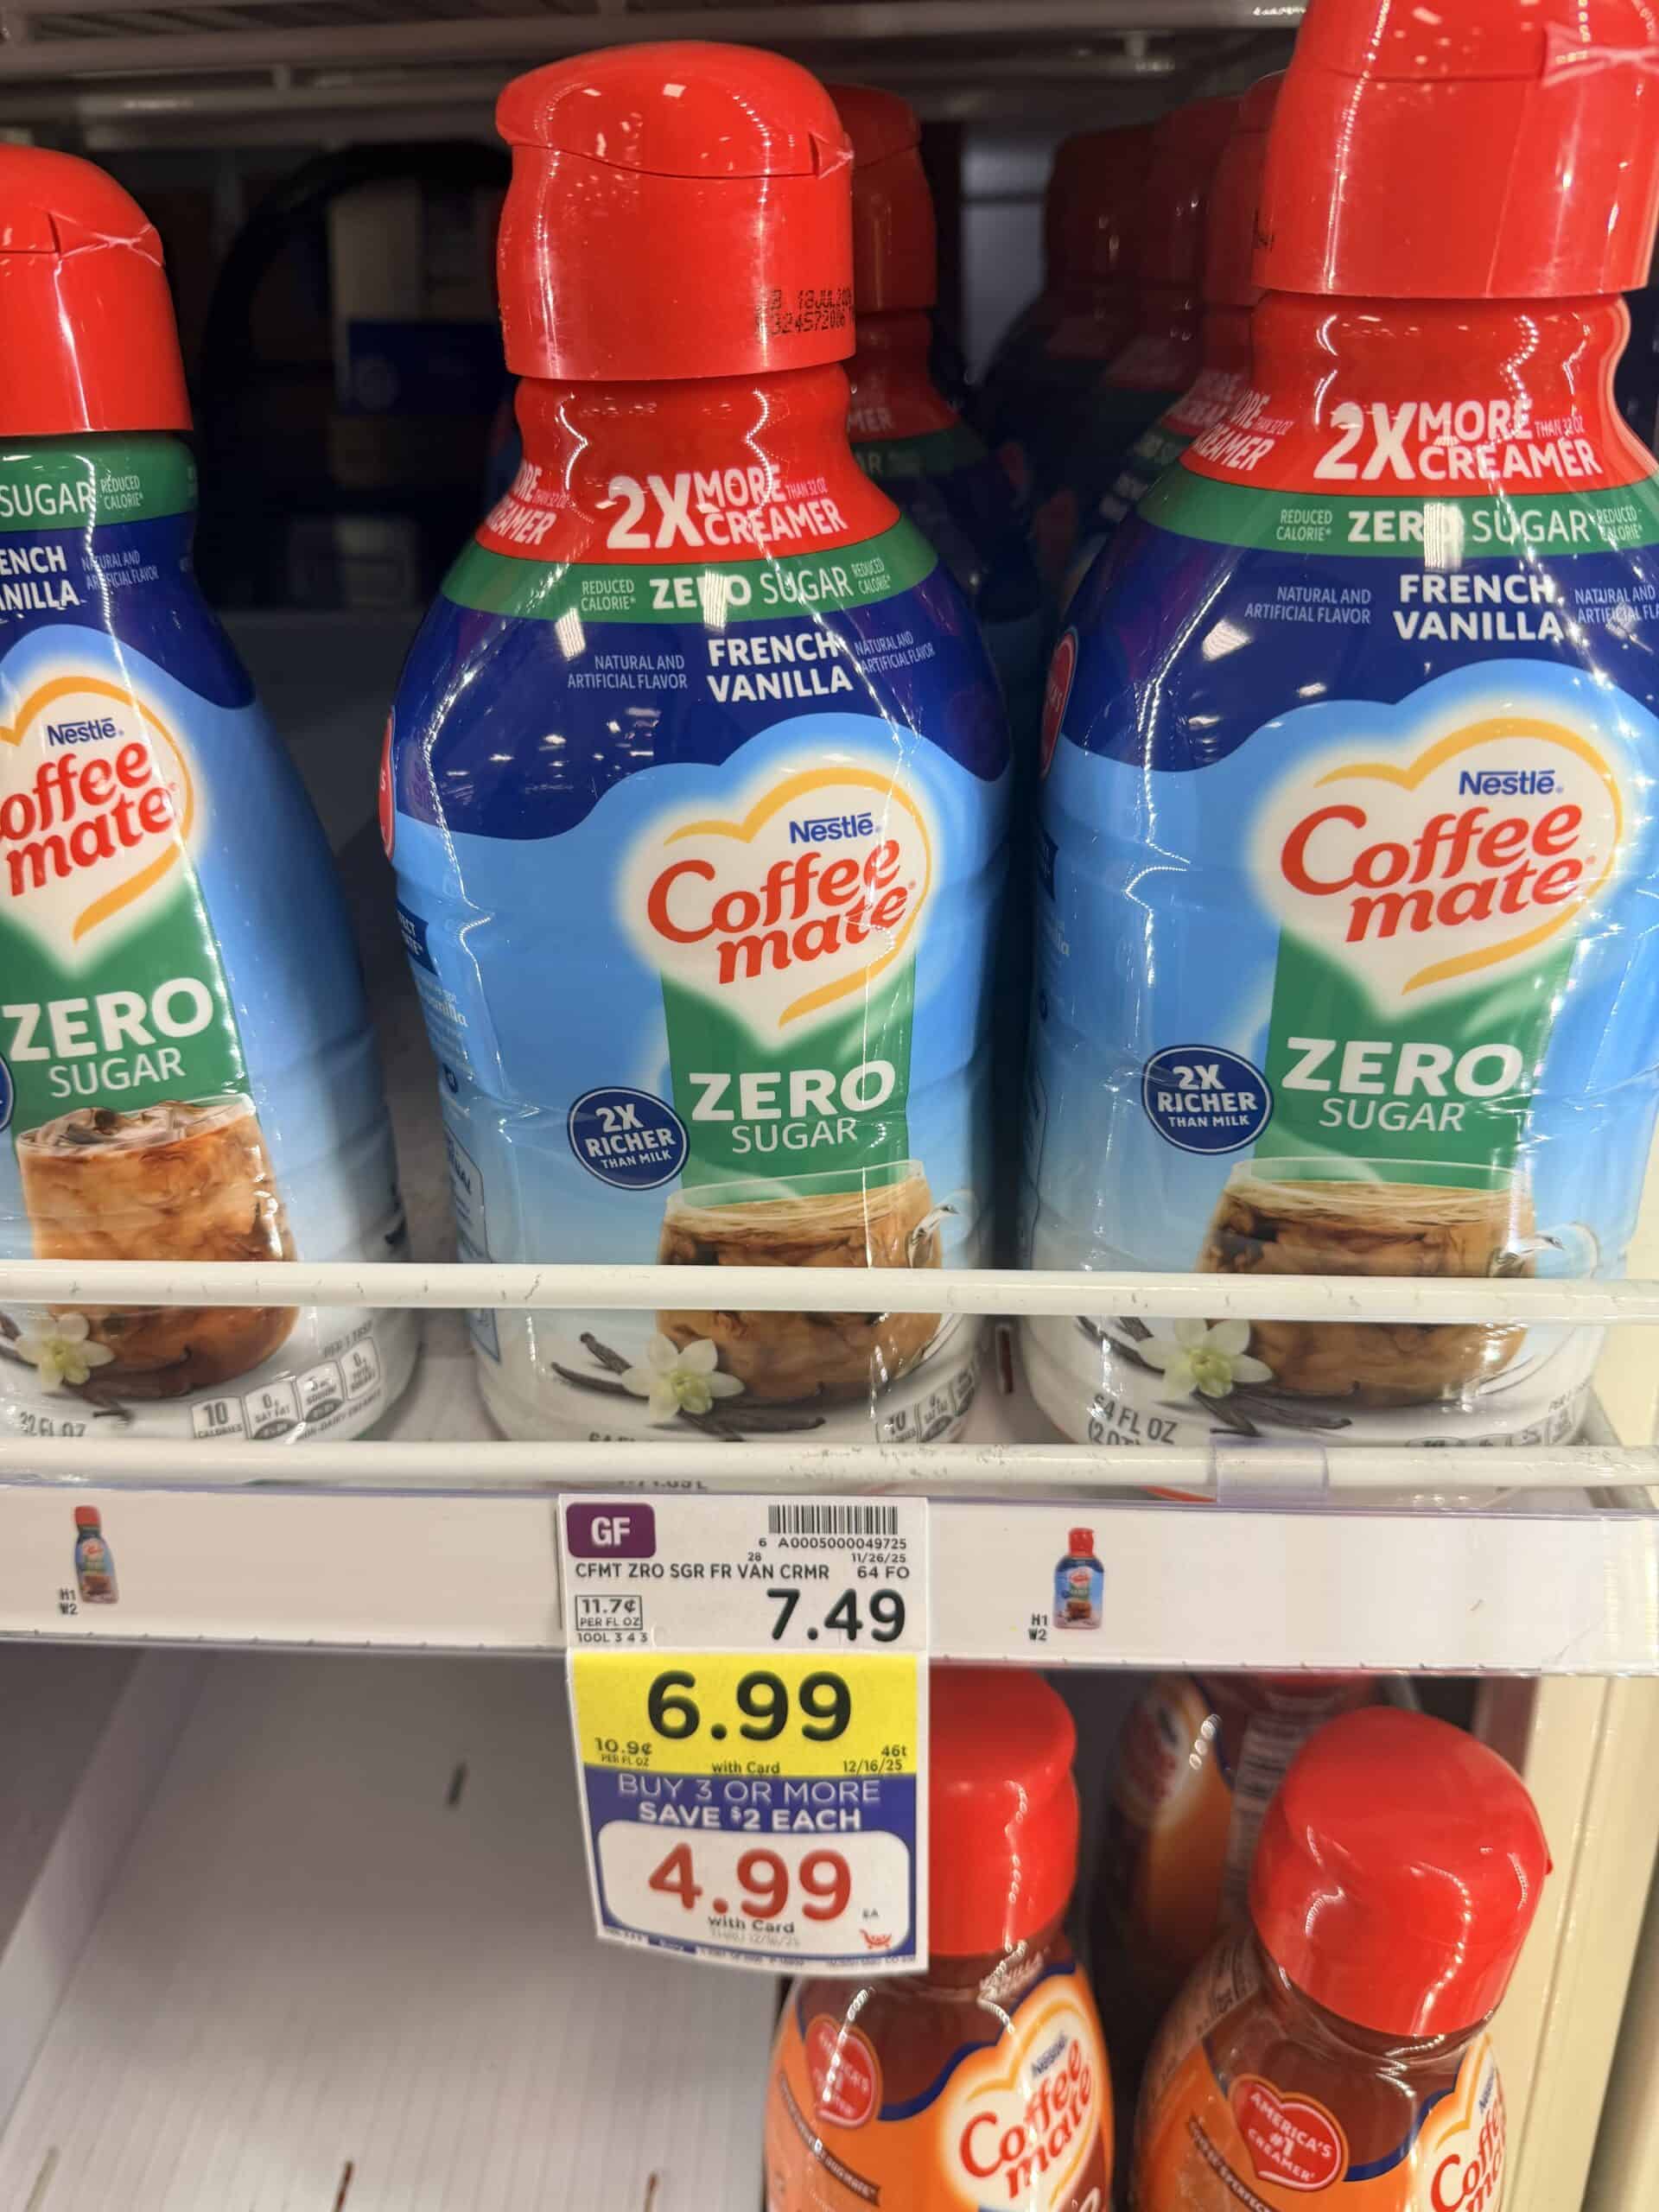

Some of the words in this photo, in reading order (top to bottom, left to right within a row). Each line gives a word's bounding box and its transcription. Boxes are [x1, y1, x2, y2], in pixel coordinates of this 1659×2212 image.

[1419, 397, 1534, 442] MORE
[1313, 401, 1416, 480] 2X
[1419, 439, 1604, 480] CREAMER
[0, 480, 95, 518] SUGAR
[100, 475, 140, 494] REDUCED
[693, 464, 788, 510] MORE
[607, 472, 706, 550] 2X
[704, 498, 848, 546] CREAMER
[1281, 509, 1333, 525] REDUCED
[1597, 505, 1638, 525] REDUCED
[1471, 510, 1591, 544] SUGAR
[124, 550, 141, 566] AND
[851, 557, 885, 579] REDUCED
[581, 579, 635, 595] REDUCED
[760, 566, 854, 605] SUGAR
[1277, 587, 1338, 604] NATURAL
[1340, 588, 1372, 605] AND
[1399, 574, 1555, 604] FRENCH
[1574, 587, 1630, 605] NATURAL
[1631, 584, 1656, 603] AND
[1244, 604, 1318, 622] ARTIFICIAL
[1319, 607, 1372, 625] FLAVOR
[1393, 610, 1565, 641] VANILLA
[707, 632, 839, 667] FRENCH
[854, 636, 899, 657] NATURAL
[897, 631, 914, 649] AND
[861, 648, 911, 674] ARTIFICIAL
[908, 642, 935, 665] FLAVOR
[594, 655, 657, 671] NATURAL
[658, 654, 685, 671] AND
[567, 673, 637, 690] ARTIFICIAL
[638, 672, 688, 690] FLAVOR
[707, 664, 854, 703] VANILLA
[0, 741, 153, 841] offee
[7, 786, 174, 897] mate
[1281, 804, 1582, 896] Coffee
[647, 839, 900, 944] Coffee
[1345, 858, 1584, 944] mate
[716, 886, 908, 985] mate
[2, 977, 213, 1062] ZERO
[48, 1046, 187, 1098] SUGAR
[1172, 1065, 1225, 1090] 2X
[1281, 1036, 1523, 1098] ZERO
[689, 1059, 896, 1122] ZERO
[1157, 1091, 1259, 1113] RICHER
[594, 1103, 645, 1134] 2X
[1167, 1115, 1209, 1129] THAN
[1211, 1113, 1249, 1128] MILK
[1319, 1098, 1466, 1132] SUGAR
[584, 1126, 677, 1160] RICHER
[731, 1117, 858, 1154] SUGAR
[600, 1154, 637, 1170] THAN
[639, 1148, 672, 1166] MILK
[203, 1401, 229, 1427] 10
[1117, 1407, 1141, 1435] FL
[1147, 1417, 1178, 1445] OZ
[591, 1516, 631, 1547] GF
[759, 1538, 767, 1548] 6
[779, 1537, 907, 1550] A0005000049725
[575, 1562, 621, 1579] CFMT
[628, 1562, 664, 1579] ZRO
[670, 1563, 705, 1580] SGR
[710, 1564, 732, 1580] FR
[738, 1563, 775, 1580] VAN
[780, 1564, 830, 1580] CRMR
[856, 1566, 879, 1580] 64
[885, 1566, 910, 1580] FO
[851, 1552, 906, 1564] 11/26/25
[580, 1617, 603, 1628] PER
[606, 1617, 620, 1627] FL
[623, 1617, 640, 1627] OZ
[766, 1587, 906, 1643] 7.49
[1031, 1613, 1048, 1626] H1
[647, 1669, 852, 1741] 6.99
[880, 1745, 907, 1758] 46t
[712, 1760, 744, 1775] with
[747, 1761, 781, 1776] Card
[842, 1759, 903, 1777] 12/16/25
[618, 1774, 684, 1799] BUY
[695, 1780, 713, 1802] 3
[724, 1781, 772, 1804] OR
[784, 1780, 881, 1804] MORE
[639, 1802, 721, 1828] SAVE
[731, 1807, 761, 1831] $2
[772, 1808, 862, 1831] EACH
[648, 1841, 853, 1923] 4.99
[708, 1914, 747, 1933] with
[751, 1917, 796, 1935] Card
[1249, 2092, 1333, 2158] AMERICA'S
